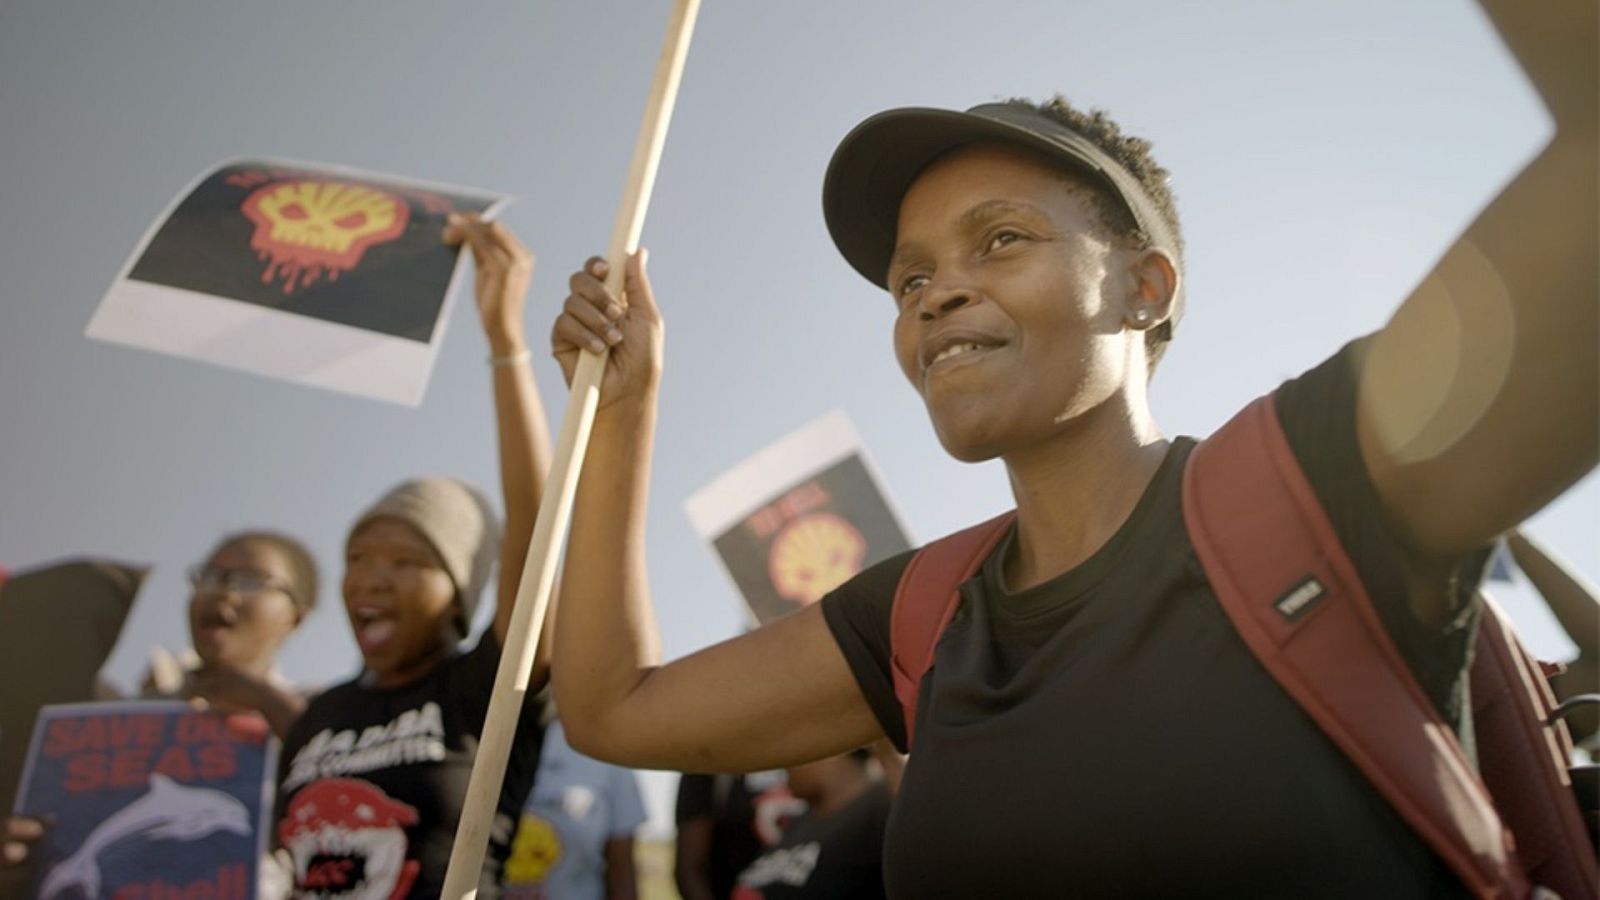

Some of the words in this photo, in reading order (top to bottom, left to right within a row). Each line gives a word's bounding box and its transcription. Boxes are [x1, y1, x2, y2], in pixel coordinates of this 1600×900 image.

[45, 713, 166, 757] SAVE
[175, 712, 255, 745] OU
[64, 743, 237, 794] SEAS
